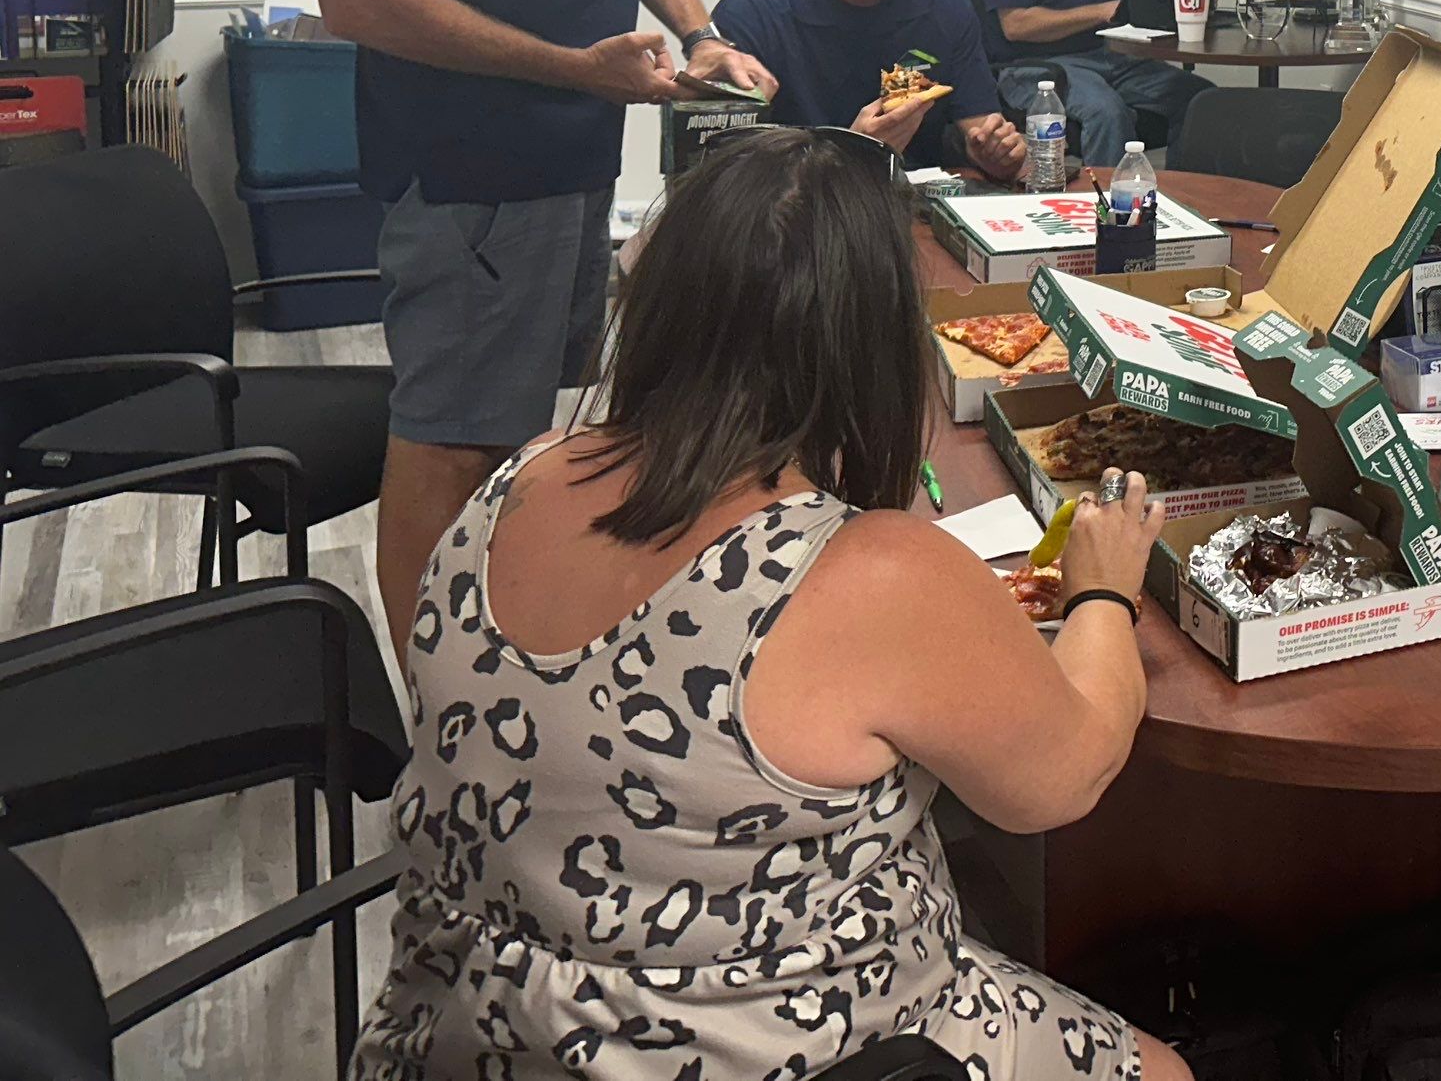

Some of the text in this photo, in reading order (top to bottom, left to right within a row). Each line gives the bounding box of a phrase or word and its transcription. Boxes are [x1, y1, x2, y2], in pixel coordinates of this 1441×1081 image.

[687, 112, 759, 130] MONDAY NIGHT
[1242, 329, 1276, 353] FREE
[1121, 372, 1169, 398] PAPA
[1325, 364, 1355, 385] PAPA
[1120, 388, 1169, 412] REWARDS
[1178, 392, 1251, 419] EARN FREE FOOD
[1384, 449, 1403, 482] EARNING
[1400, 478, 1414, 498] FREE
[1394, 442, 1424, 492] JOIN TO START
[1165, 493, 1200, 504] DELIVER
[1201, 491, 1220, 500] OUR
[1183, 502, 1206, 511] PAID
[1209, 500, 1220, 508] TO
[1223, 497, 1246, 507] SING
[1410, 538, 1439, 584] REWARDS
[1279, 602, 1410, 637] OUR PROMISE IS SIMPLE:
[1284, 646, 1293, 654] be
[1293, 640, 1328, 652] passionate
[1329, 636, 1347, 644] about
[1347, 633, 1358, 641] the
[1359, 628, 1380, 639] quality
[1301, 634, 1322, 642] deliver
[1336, 627, 1354, 637] every
[1354, 623, 1370, 632] pizza
[1314, 647, 1326, 655] and
[1335, 642, 1347, 650] add
[1367, 635, 1383, 643] extra
